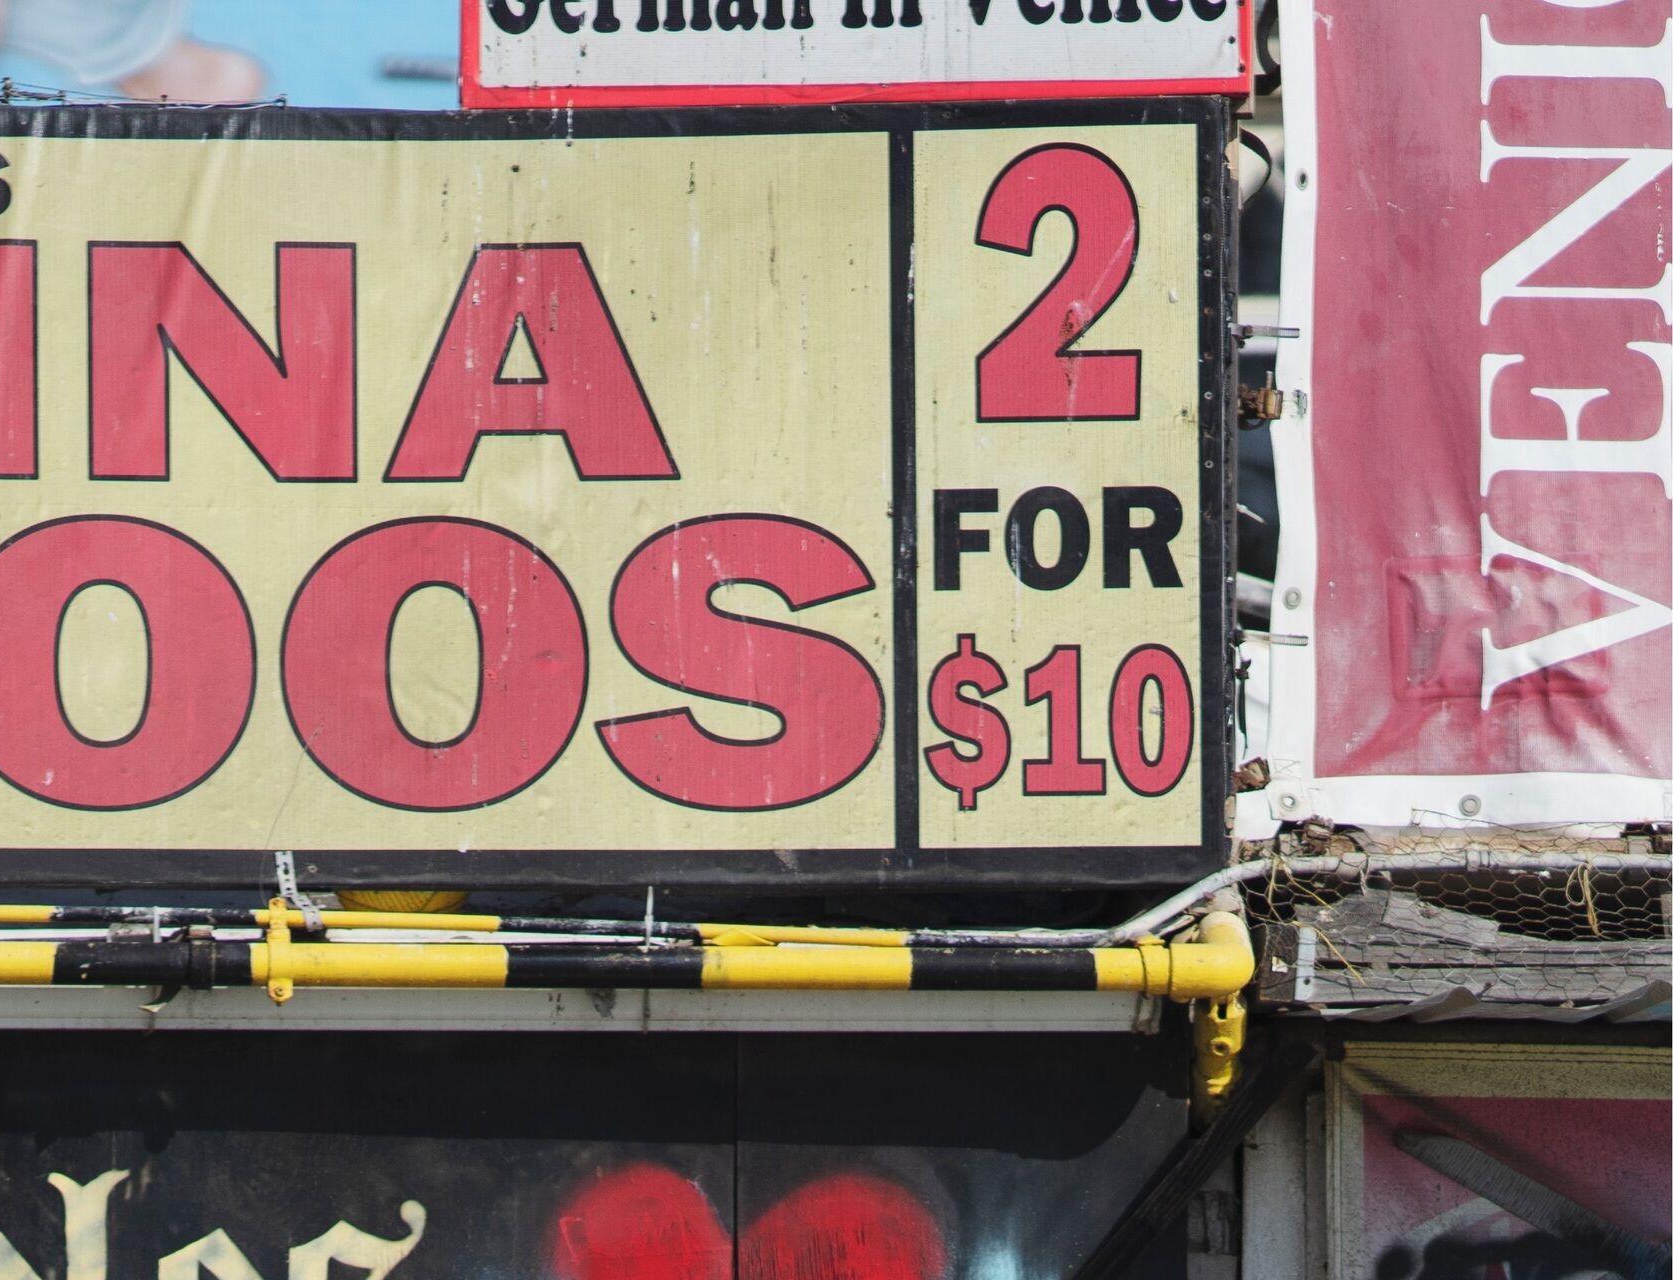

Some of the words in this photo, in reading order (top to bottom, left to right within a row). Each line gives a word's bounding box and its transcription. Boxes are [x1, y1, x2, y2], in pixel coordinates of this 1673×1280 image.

[975, 142, 1141, 423] 2
[1479, 0, 1673, 712] VENI
[932, 484, 1184, 592] FOR
[925, 633, 1195, 812] $10
